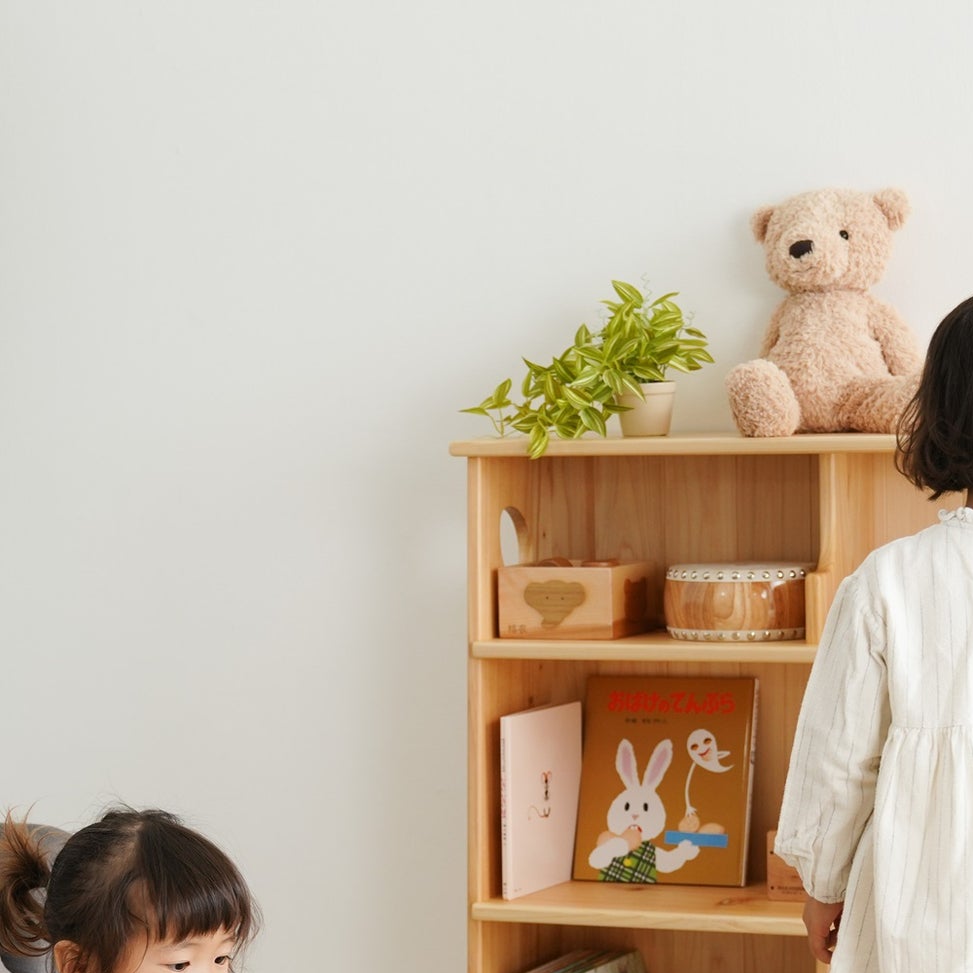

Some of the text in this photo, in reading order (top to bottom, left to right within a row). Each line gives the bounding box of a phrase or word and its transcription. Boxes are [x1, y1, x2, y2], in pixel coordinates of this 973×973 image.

[607, 690, 736, 715] おばけのてんぷら
